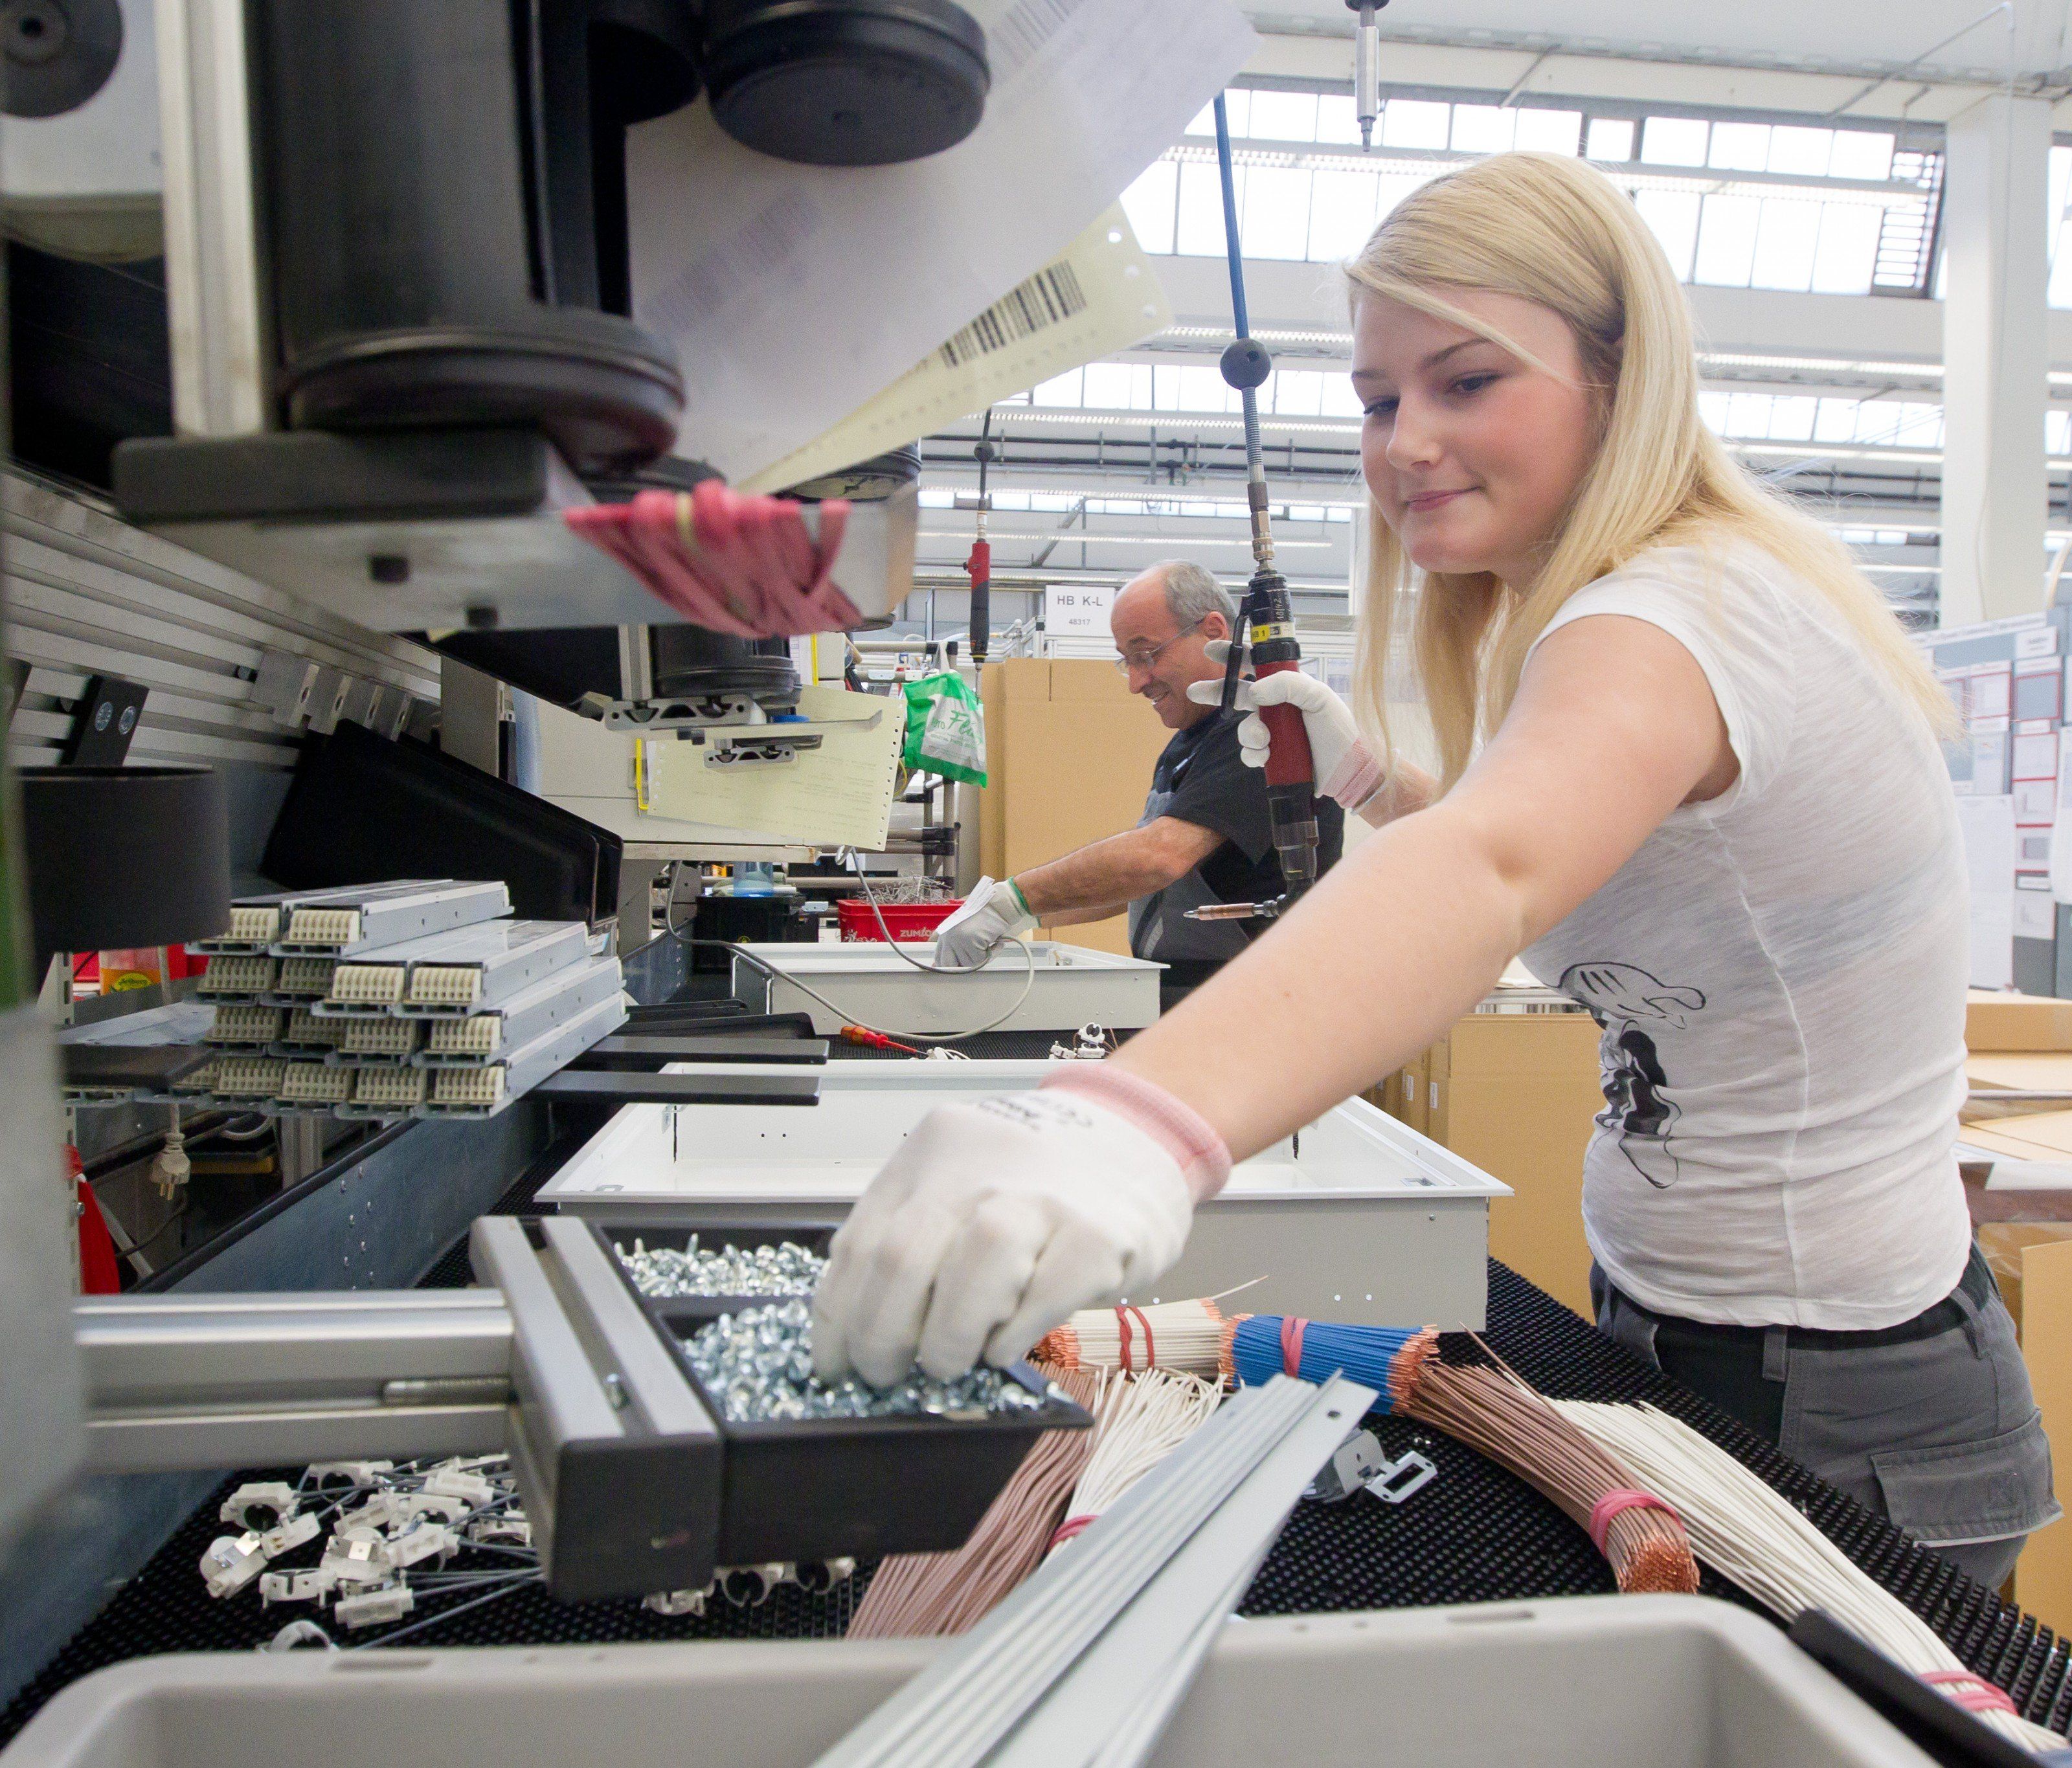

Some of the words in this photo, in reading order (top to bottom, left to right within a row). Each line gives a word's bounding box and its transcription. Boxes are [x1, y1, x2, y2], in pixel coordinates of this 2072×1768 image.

[1057, 595, 1075, 606] HB
[1083, 596, 1103, 606] K-L
[899, 927, 932, 938] ZUMTO
